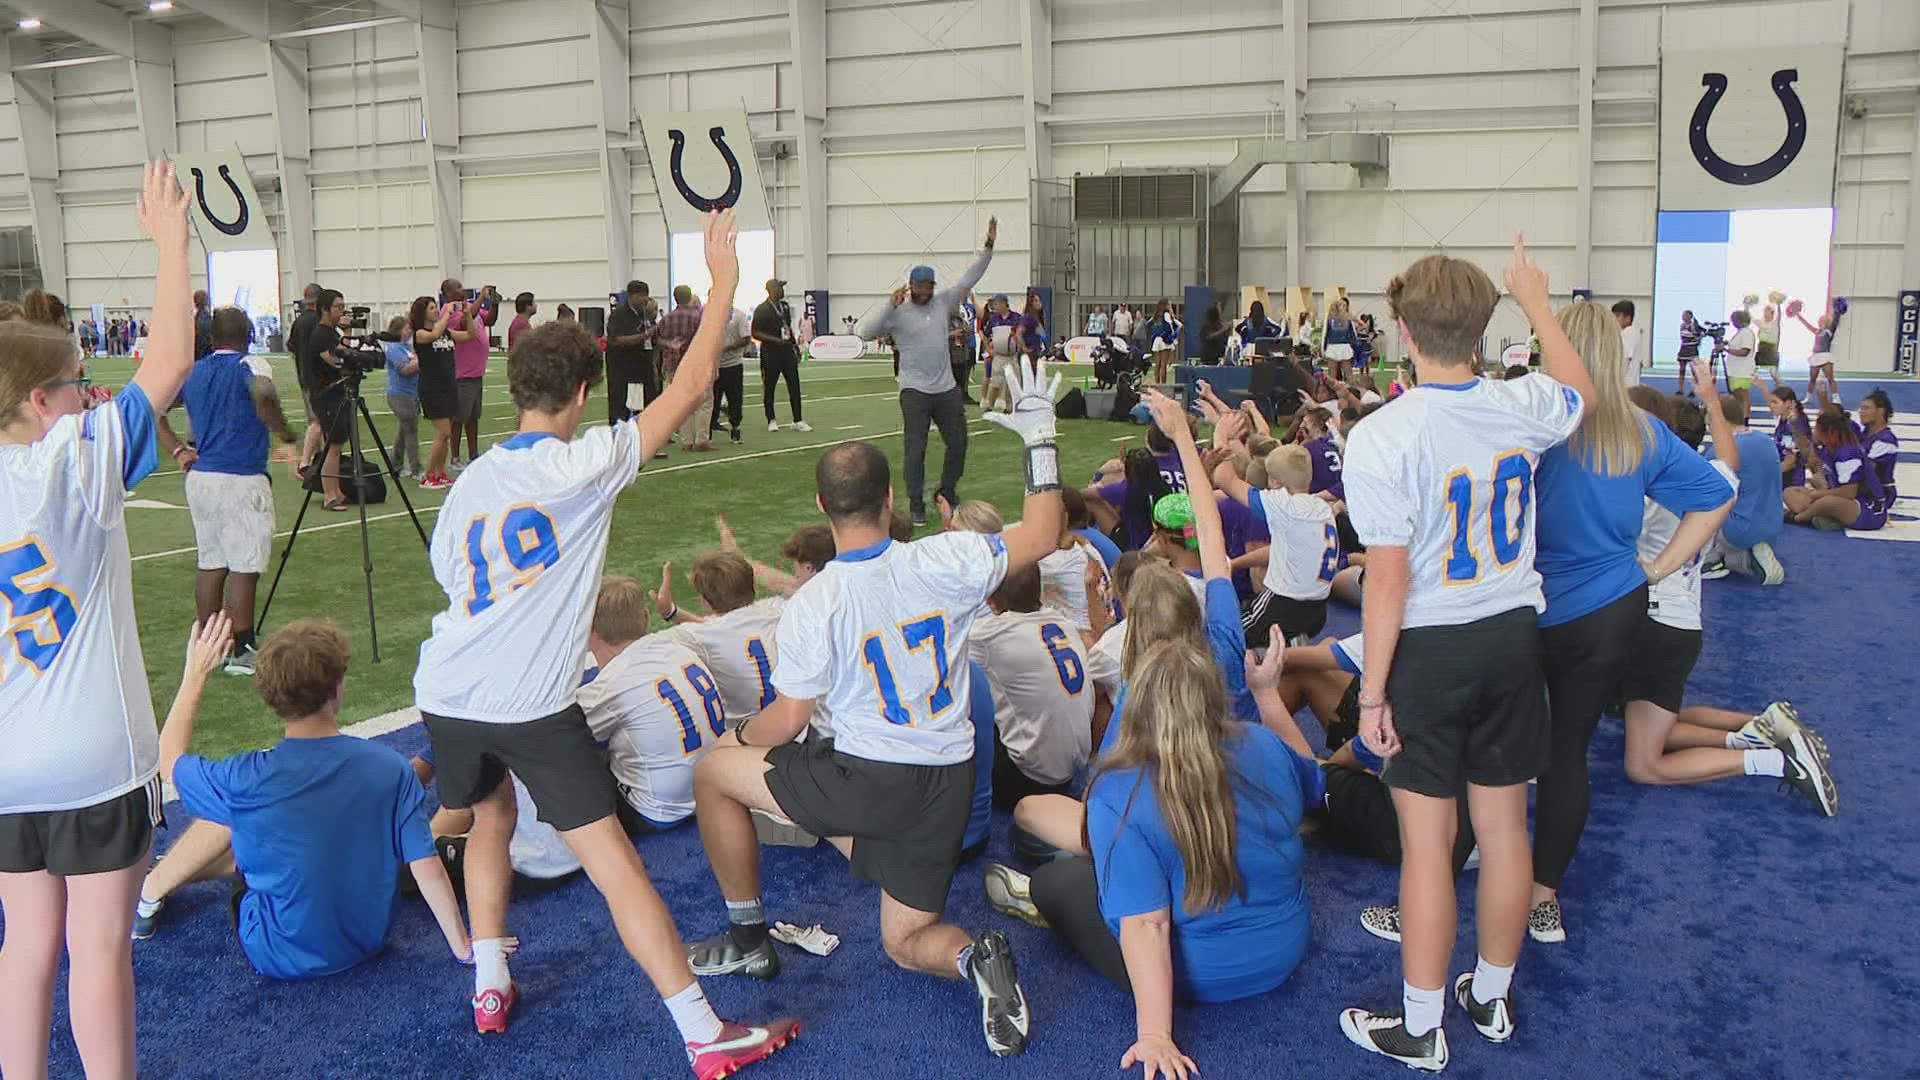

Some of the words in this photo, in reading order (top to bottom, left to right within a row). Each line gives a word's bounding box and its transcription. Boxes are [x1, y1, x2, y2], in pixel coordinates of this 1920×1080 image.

[464, 501, 561, 618] 19
[1441, 447, 1535, 587] 10
[654, 662, 726, 756] 18
[861, 607, 956, 729] 17
[1039, 621, 1086, 699] 6
